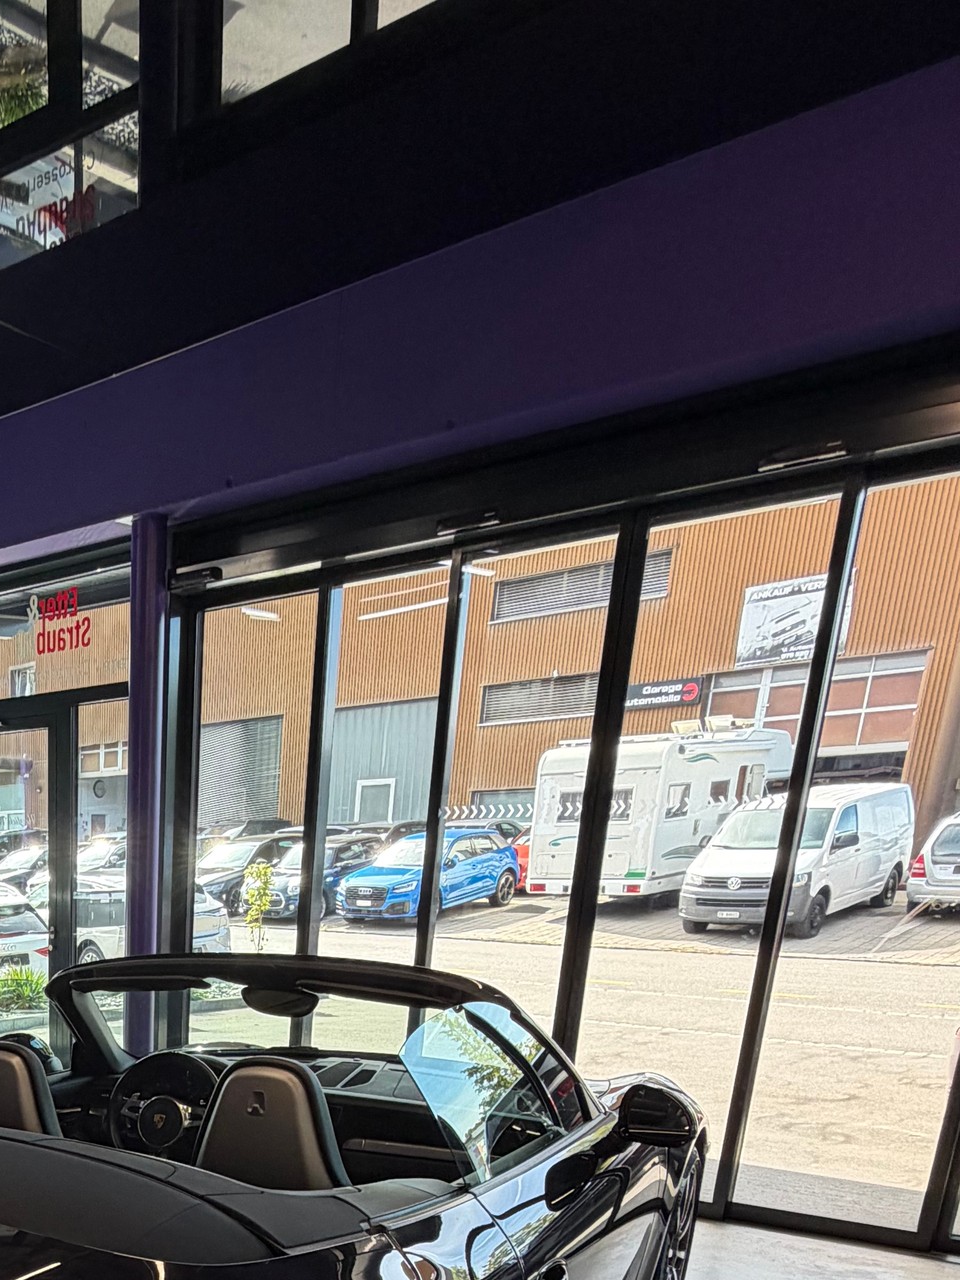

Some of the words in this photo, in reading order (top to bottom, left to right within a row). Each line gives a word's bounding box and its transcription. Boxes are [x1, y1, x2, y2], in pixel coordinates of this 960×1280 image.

[750, 585, 794, 602] ANKAUF
[642, 684, 683, 695] Garage
[625, 694, 681, 707] utomobile
